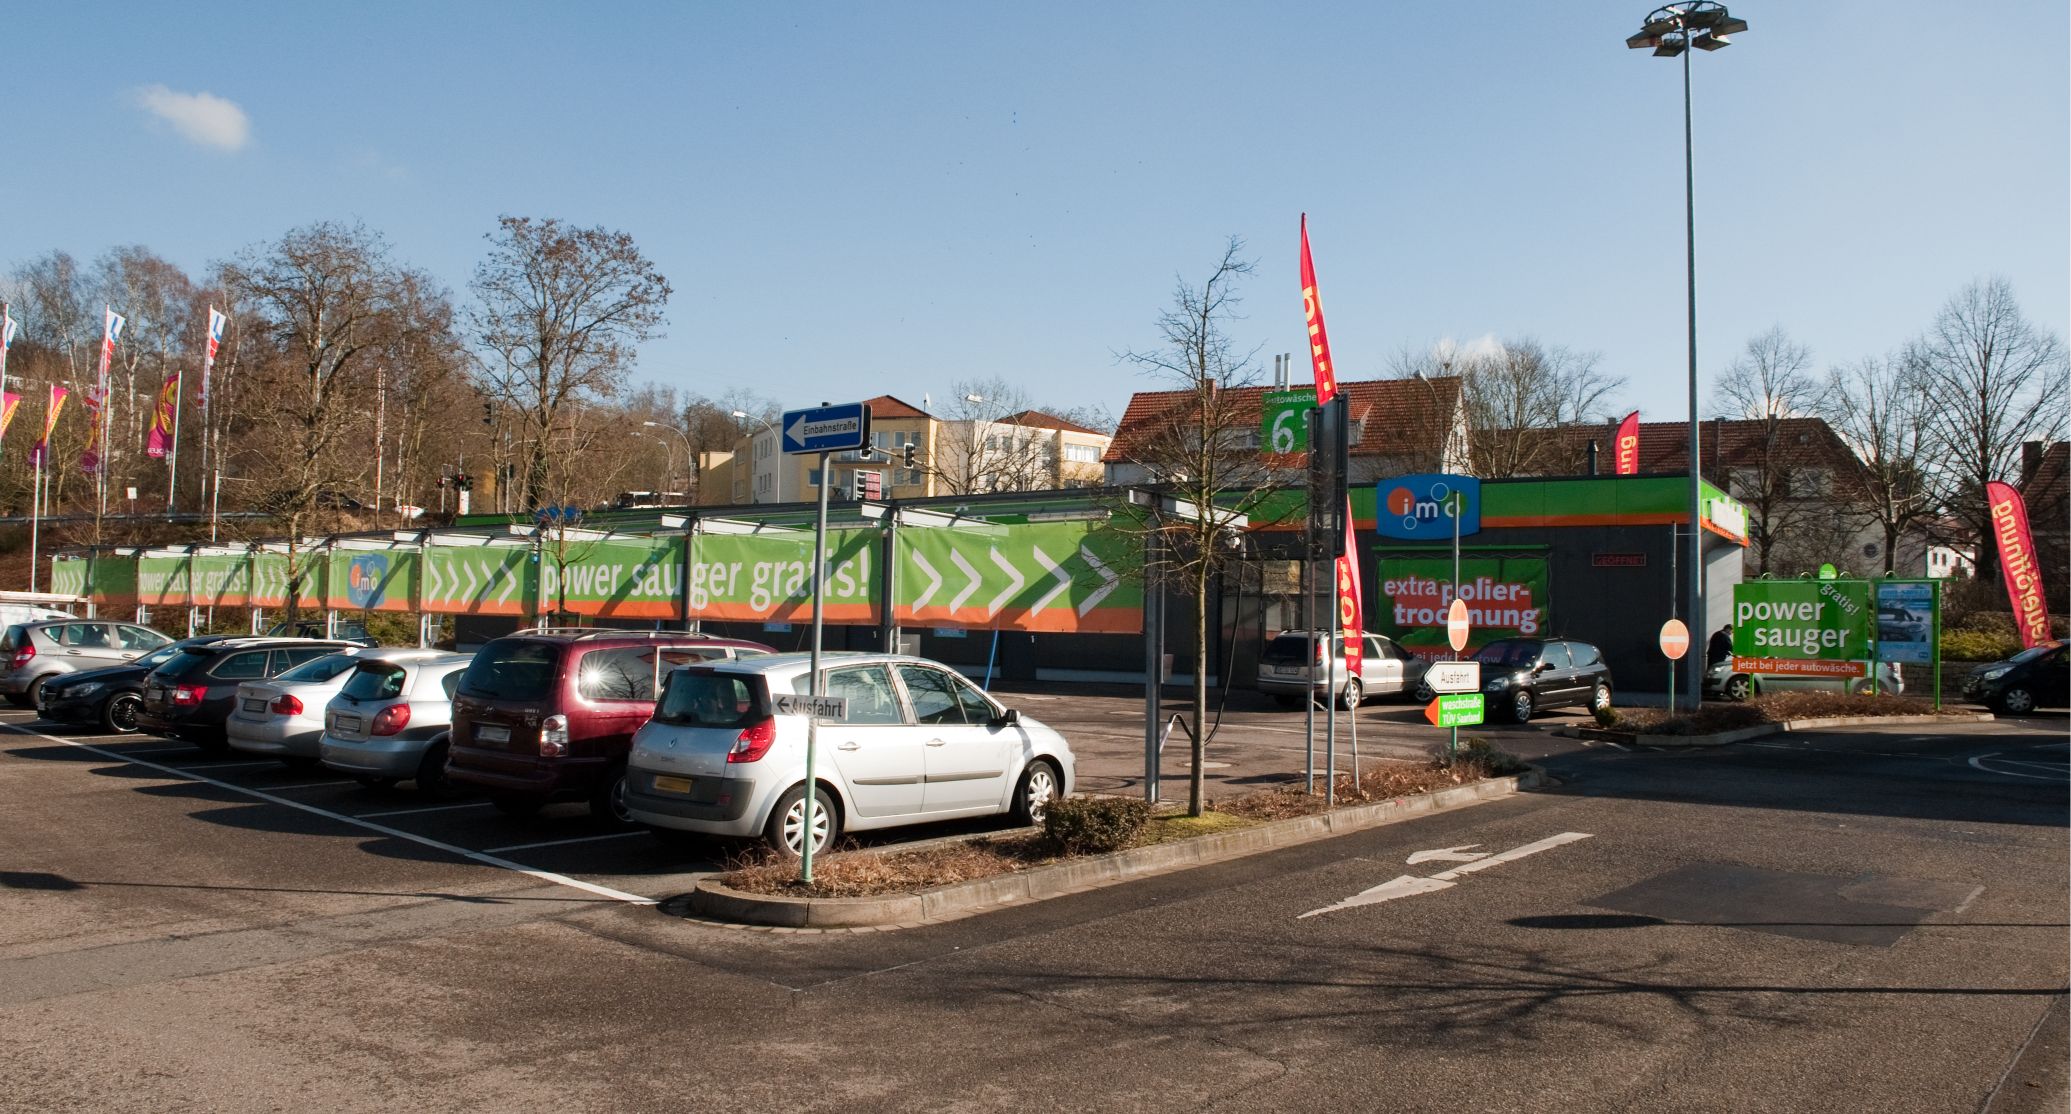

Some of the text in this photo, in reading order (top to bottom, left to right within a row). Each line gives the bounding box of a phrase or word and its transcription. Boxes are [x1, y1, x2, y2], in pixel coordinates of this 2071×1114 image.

[803, 420, 857, 435] Einbahnstraße
[543, 563, 623, 608] power
[1384, 576, 1529, 607] extra polier-
[1820, 583, 1860, 616] gratis!
[1394, 603, 1538, 634] trocnung
[1737, 601, 1825, 628] power
[1754, 626, 1850, 655] sauger
[1441, 671, 1470, 684] Ausfahrt
[1737, 661, 1860, 674] jetzt bei jeder autowäsche.
[791, 697, 842, 718] Ausfahrt
